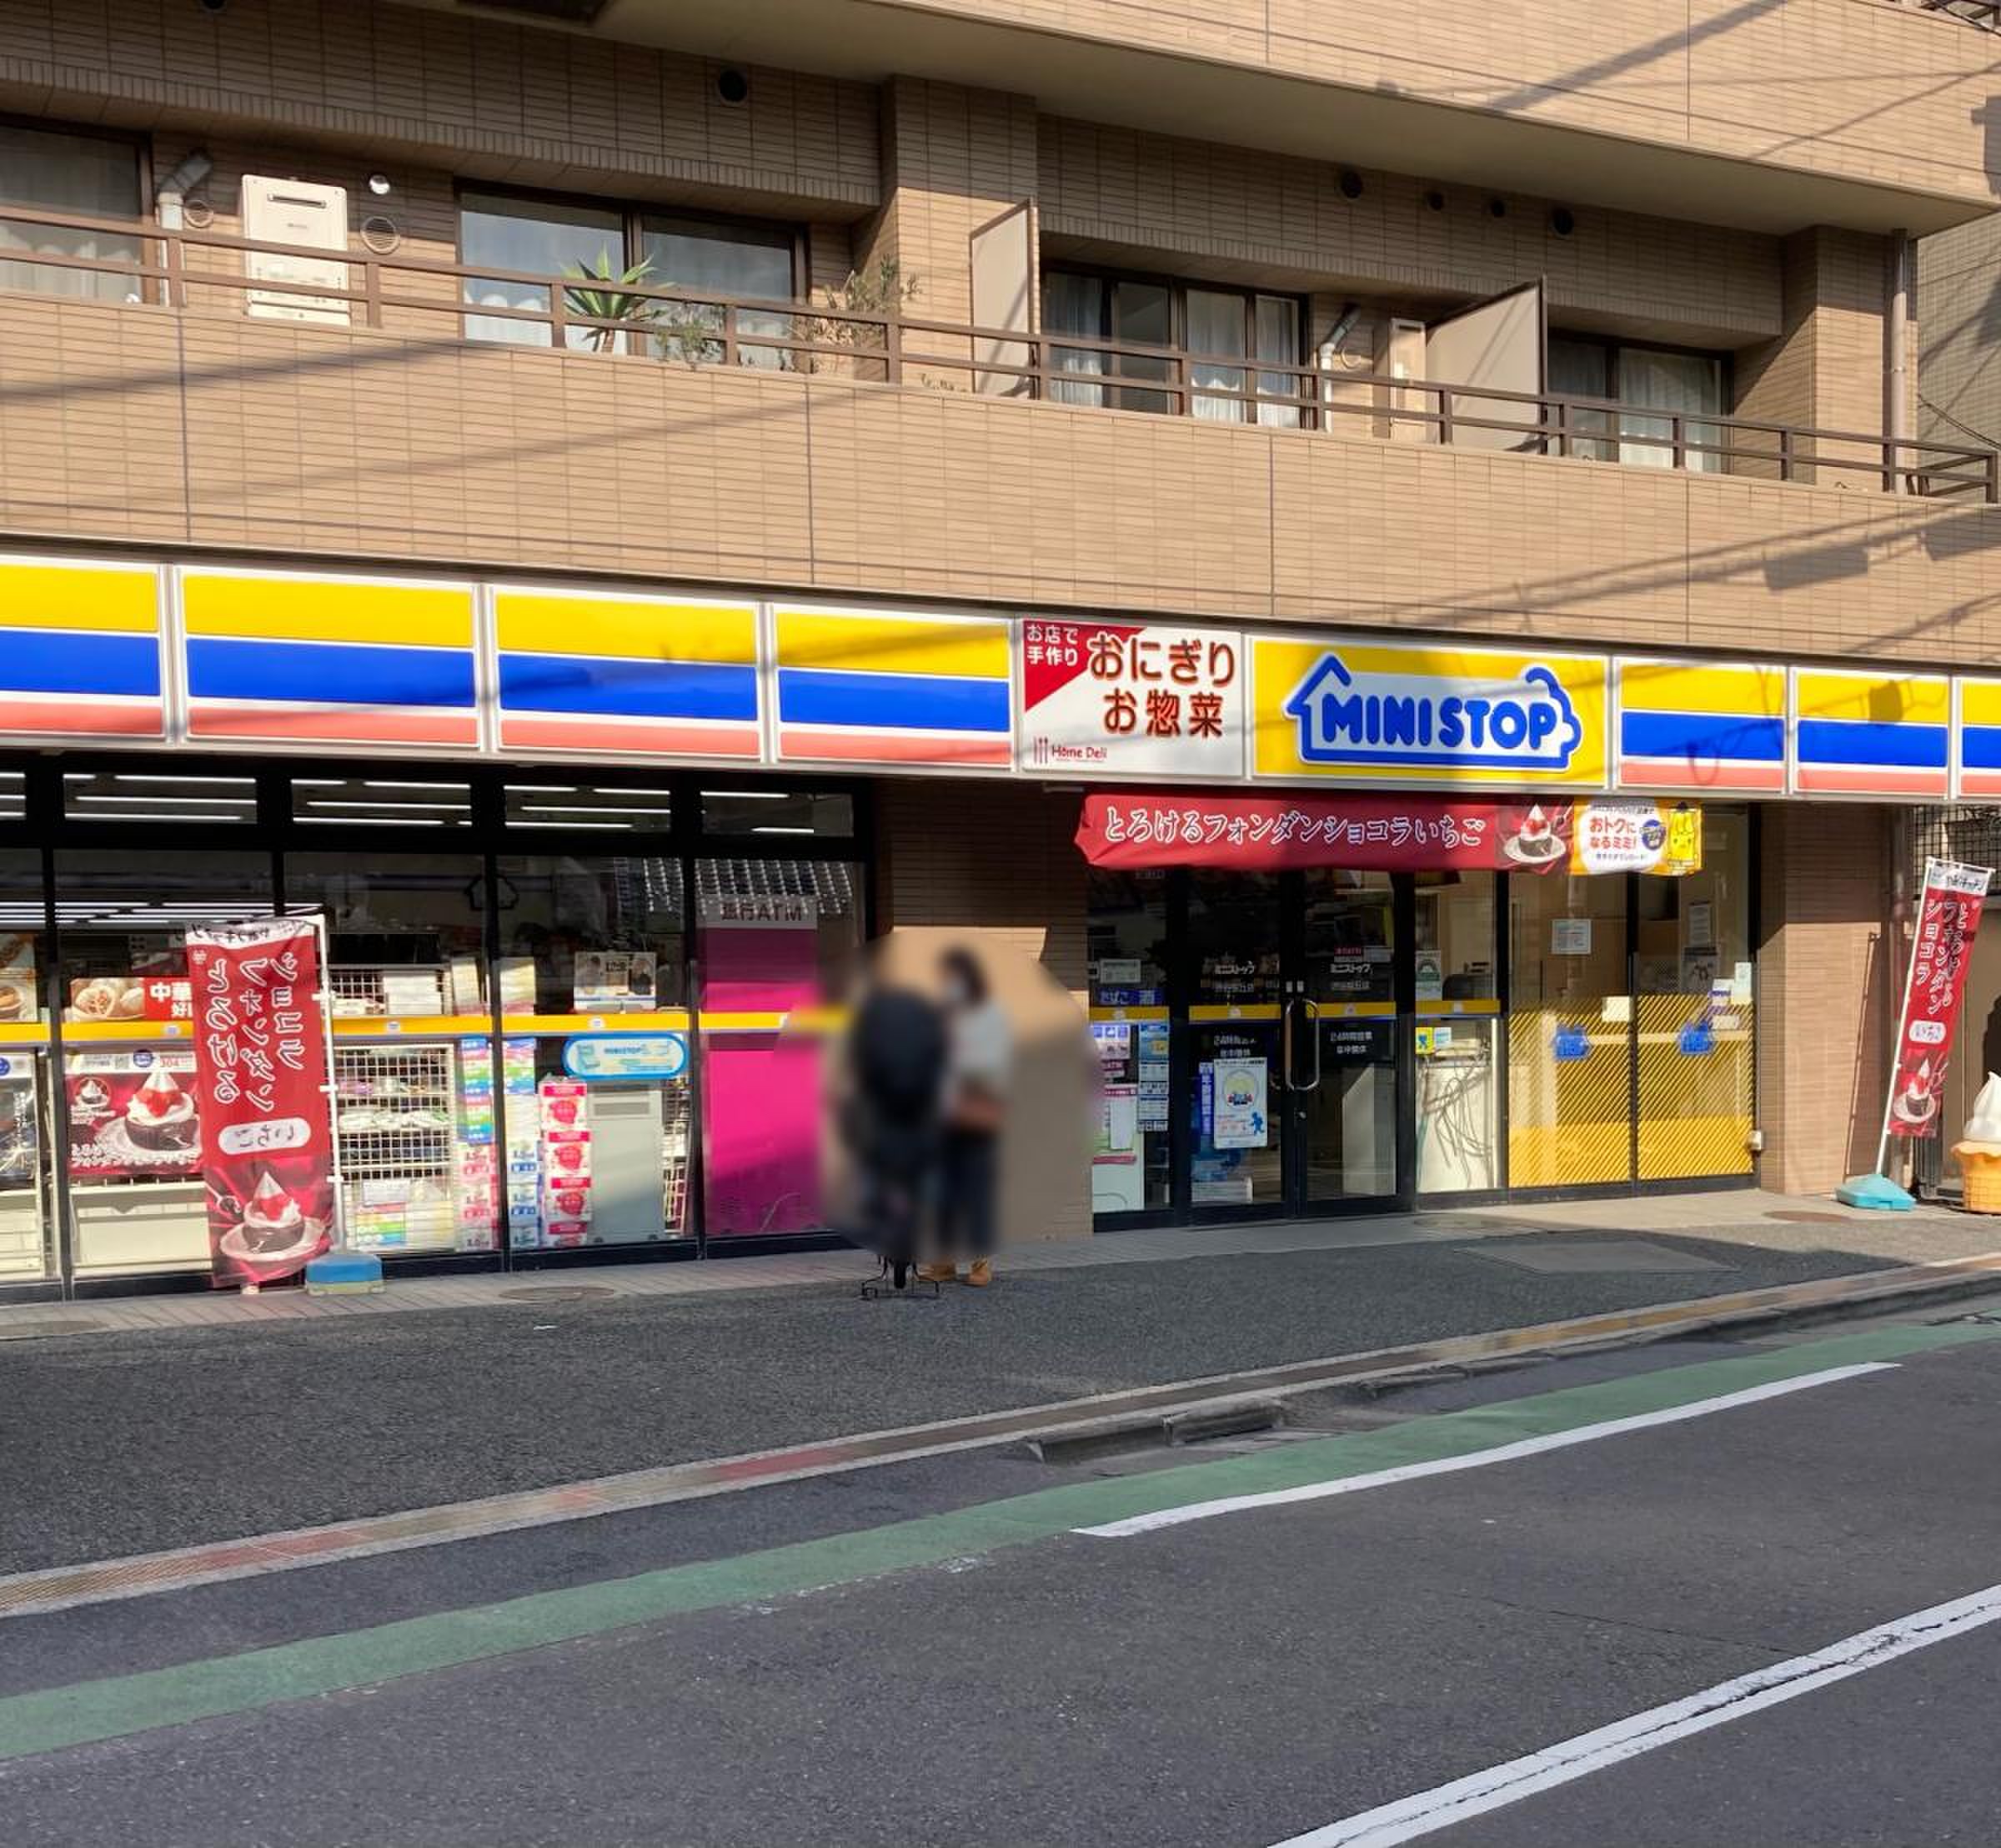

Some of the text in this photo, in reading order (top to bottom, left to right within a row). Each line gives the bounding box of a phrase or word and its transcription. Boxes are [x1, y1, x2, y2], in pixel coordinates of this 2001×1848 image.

[1026, 624, 1079, 645] お店で
[1026, 646, 1079, 666] 手作り
[1088, 633, 1236, 687] おにぎり
[1103, 687, 1224, 738] お惣菜
[1321, 692, 1557, 750] MINISTOP
[1052, 745, 1107, 759] Home Deli
[1105, 806, 1488, 849] とろけるフォンダンショコラいちご
[1589, 816, 1637, 834] おトクに
